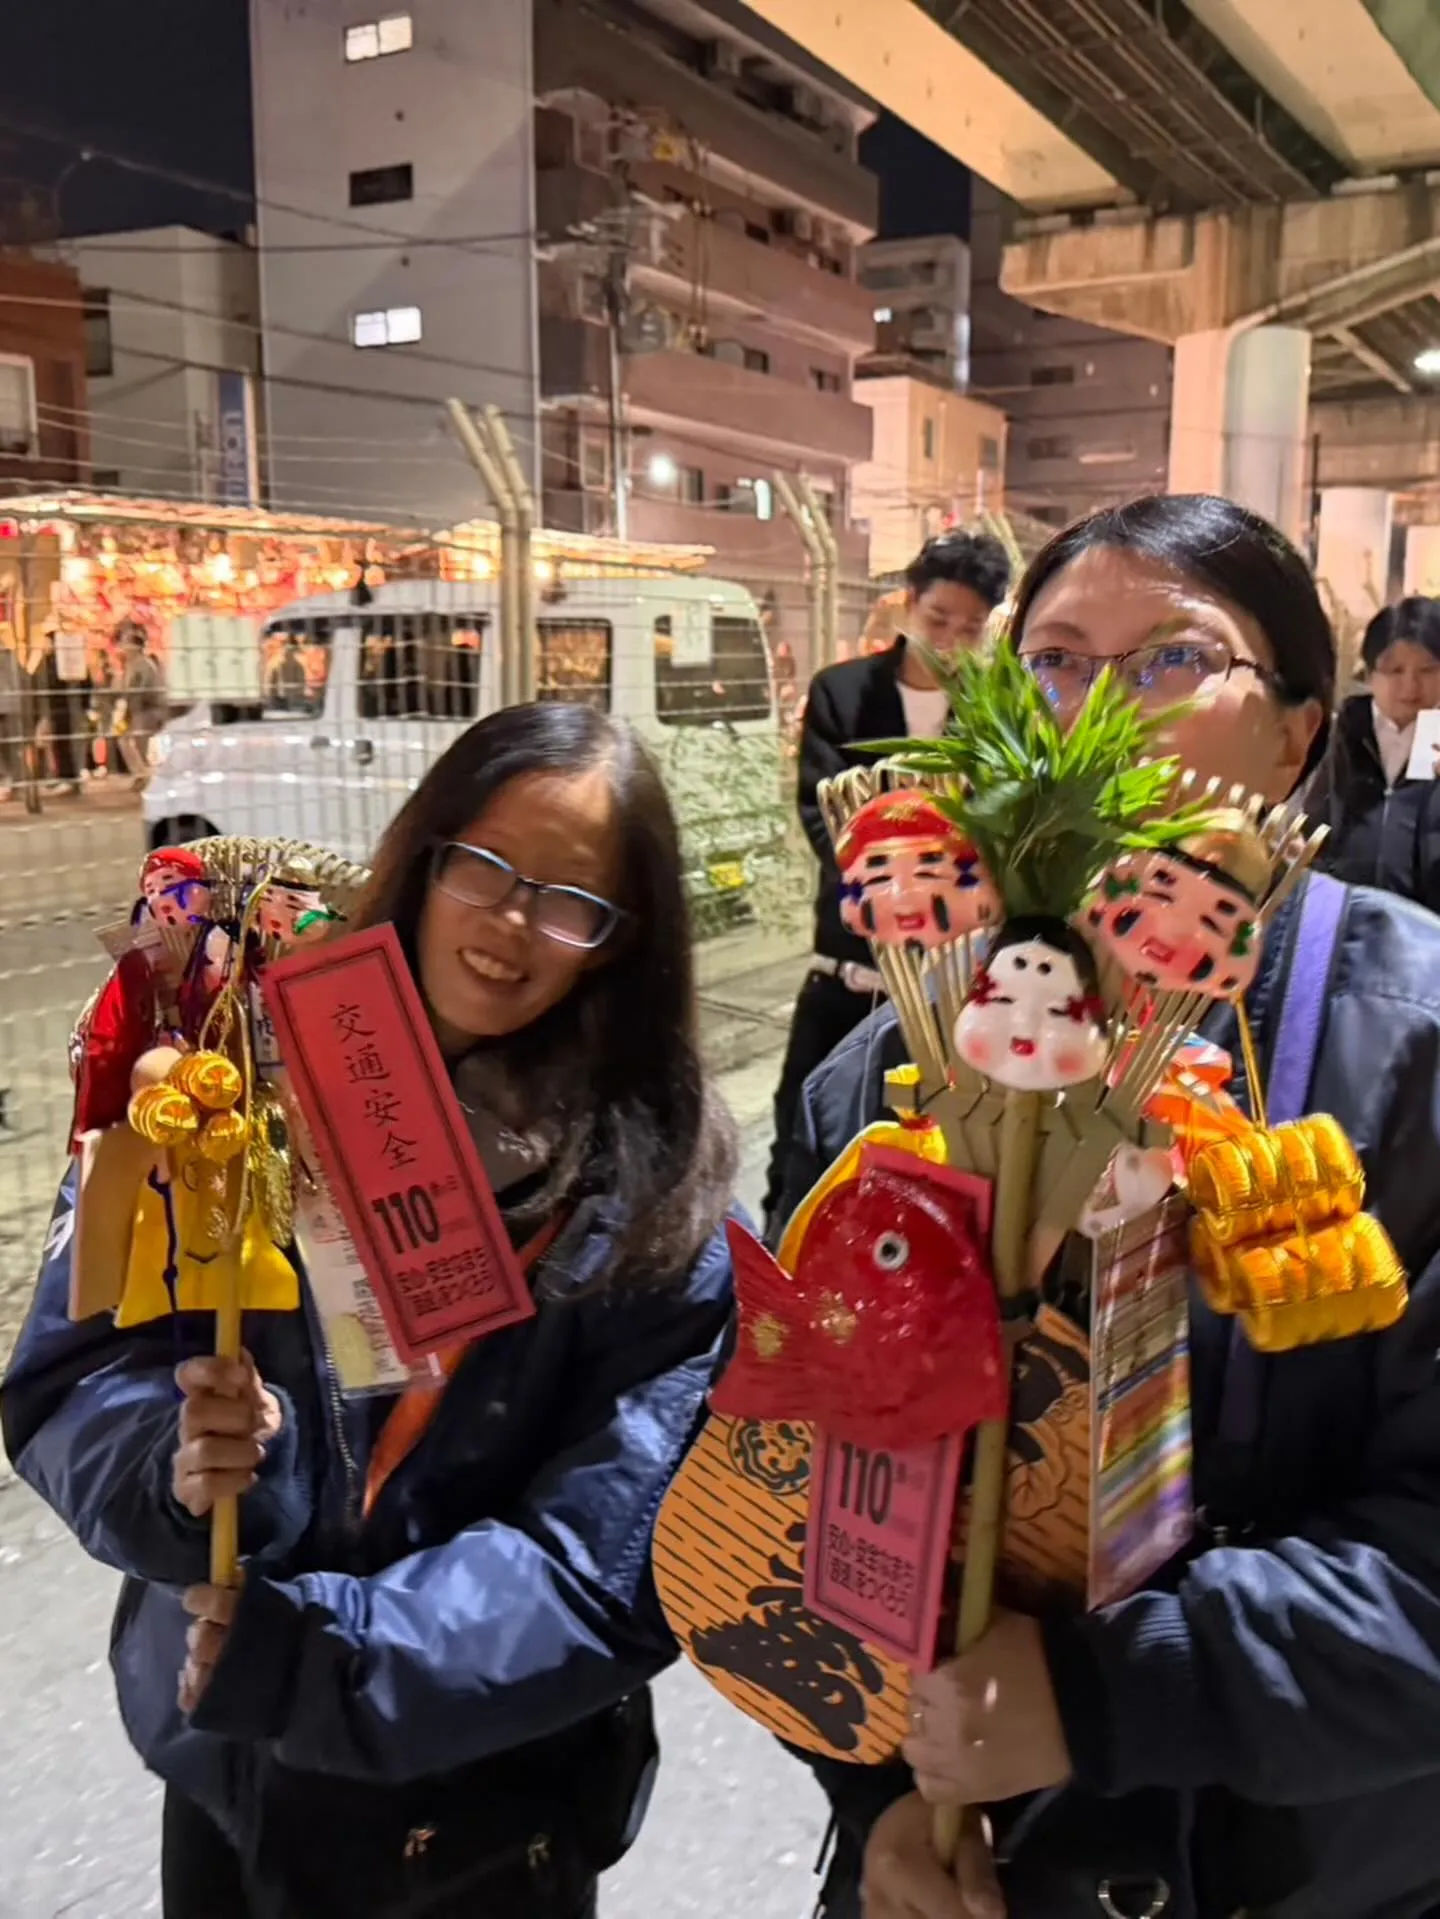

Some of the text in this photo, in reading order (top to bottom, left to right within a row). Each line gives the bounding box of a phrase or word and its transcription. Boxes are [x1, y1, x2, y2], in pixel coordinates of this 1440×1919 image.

[330, 1003, 418, 1171] 交通安全
[371, 1183, 441, 1256] 110
[839, 1441, 893, 1524] 110
